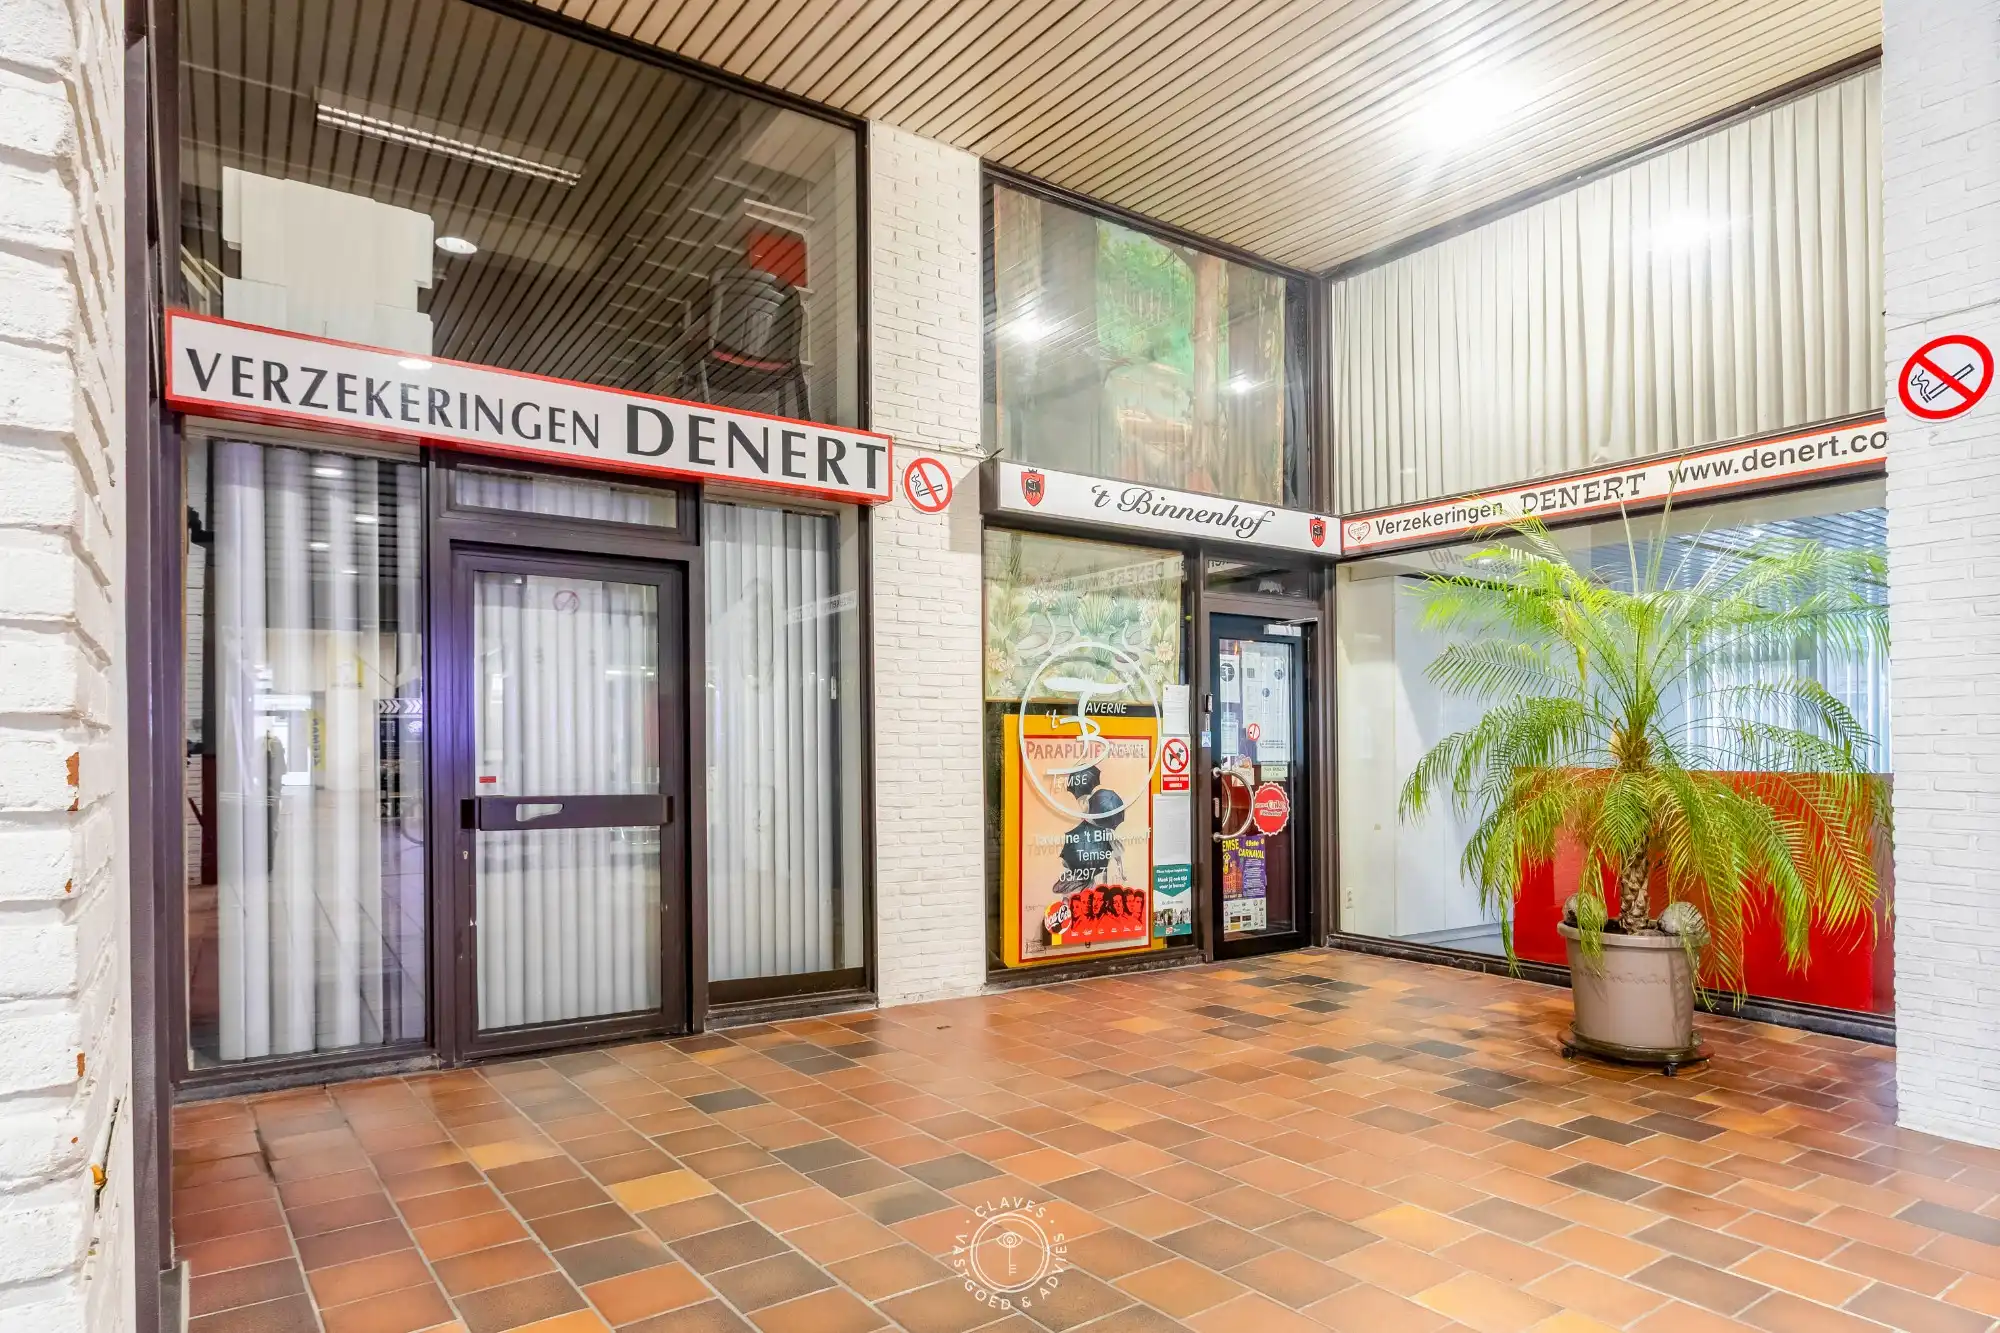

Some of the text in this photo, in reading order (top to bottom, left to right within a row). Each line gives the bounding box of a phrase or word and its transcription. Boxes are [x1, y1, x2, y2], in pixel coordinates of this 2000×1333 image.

[185, 347, 886, 490] VERZEKERINGEN DENERT
[1116, 487, 1275, 539] Binnenhof
[1375, 502, 1503, 536] Verzekeringen
[1520, 472, 1646, 514] DENERT
[1077, 849, 1113, 862] Temse
